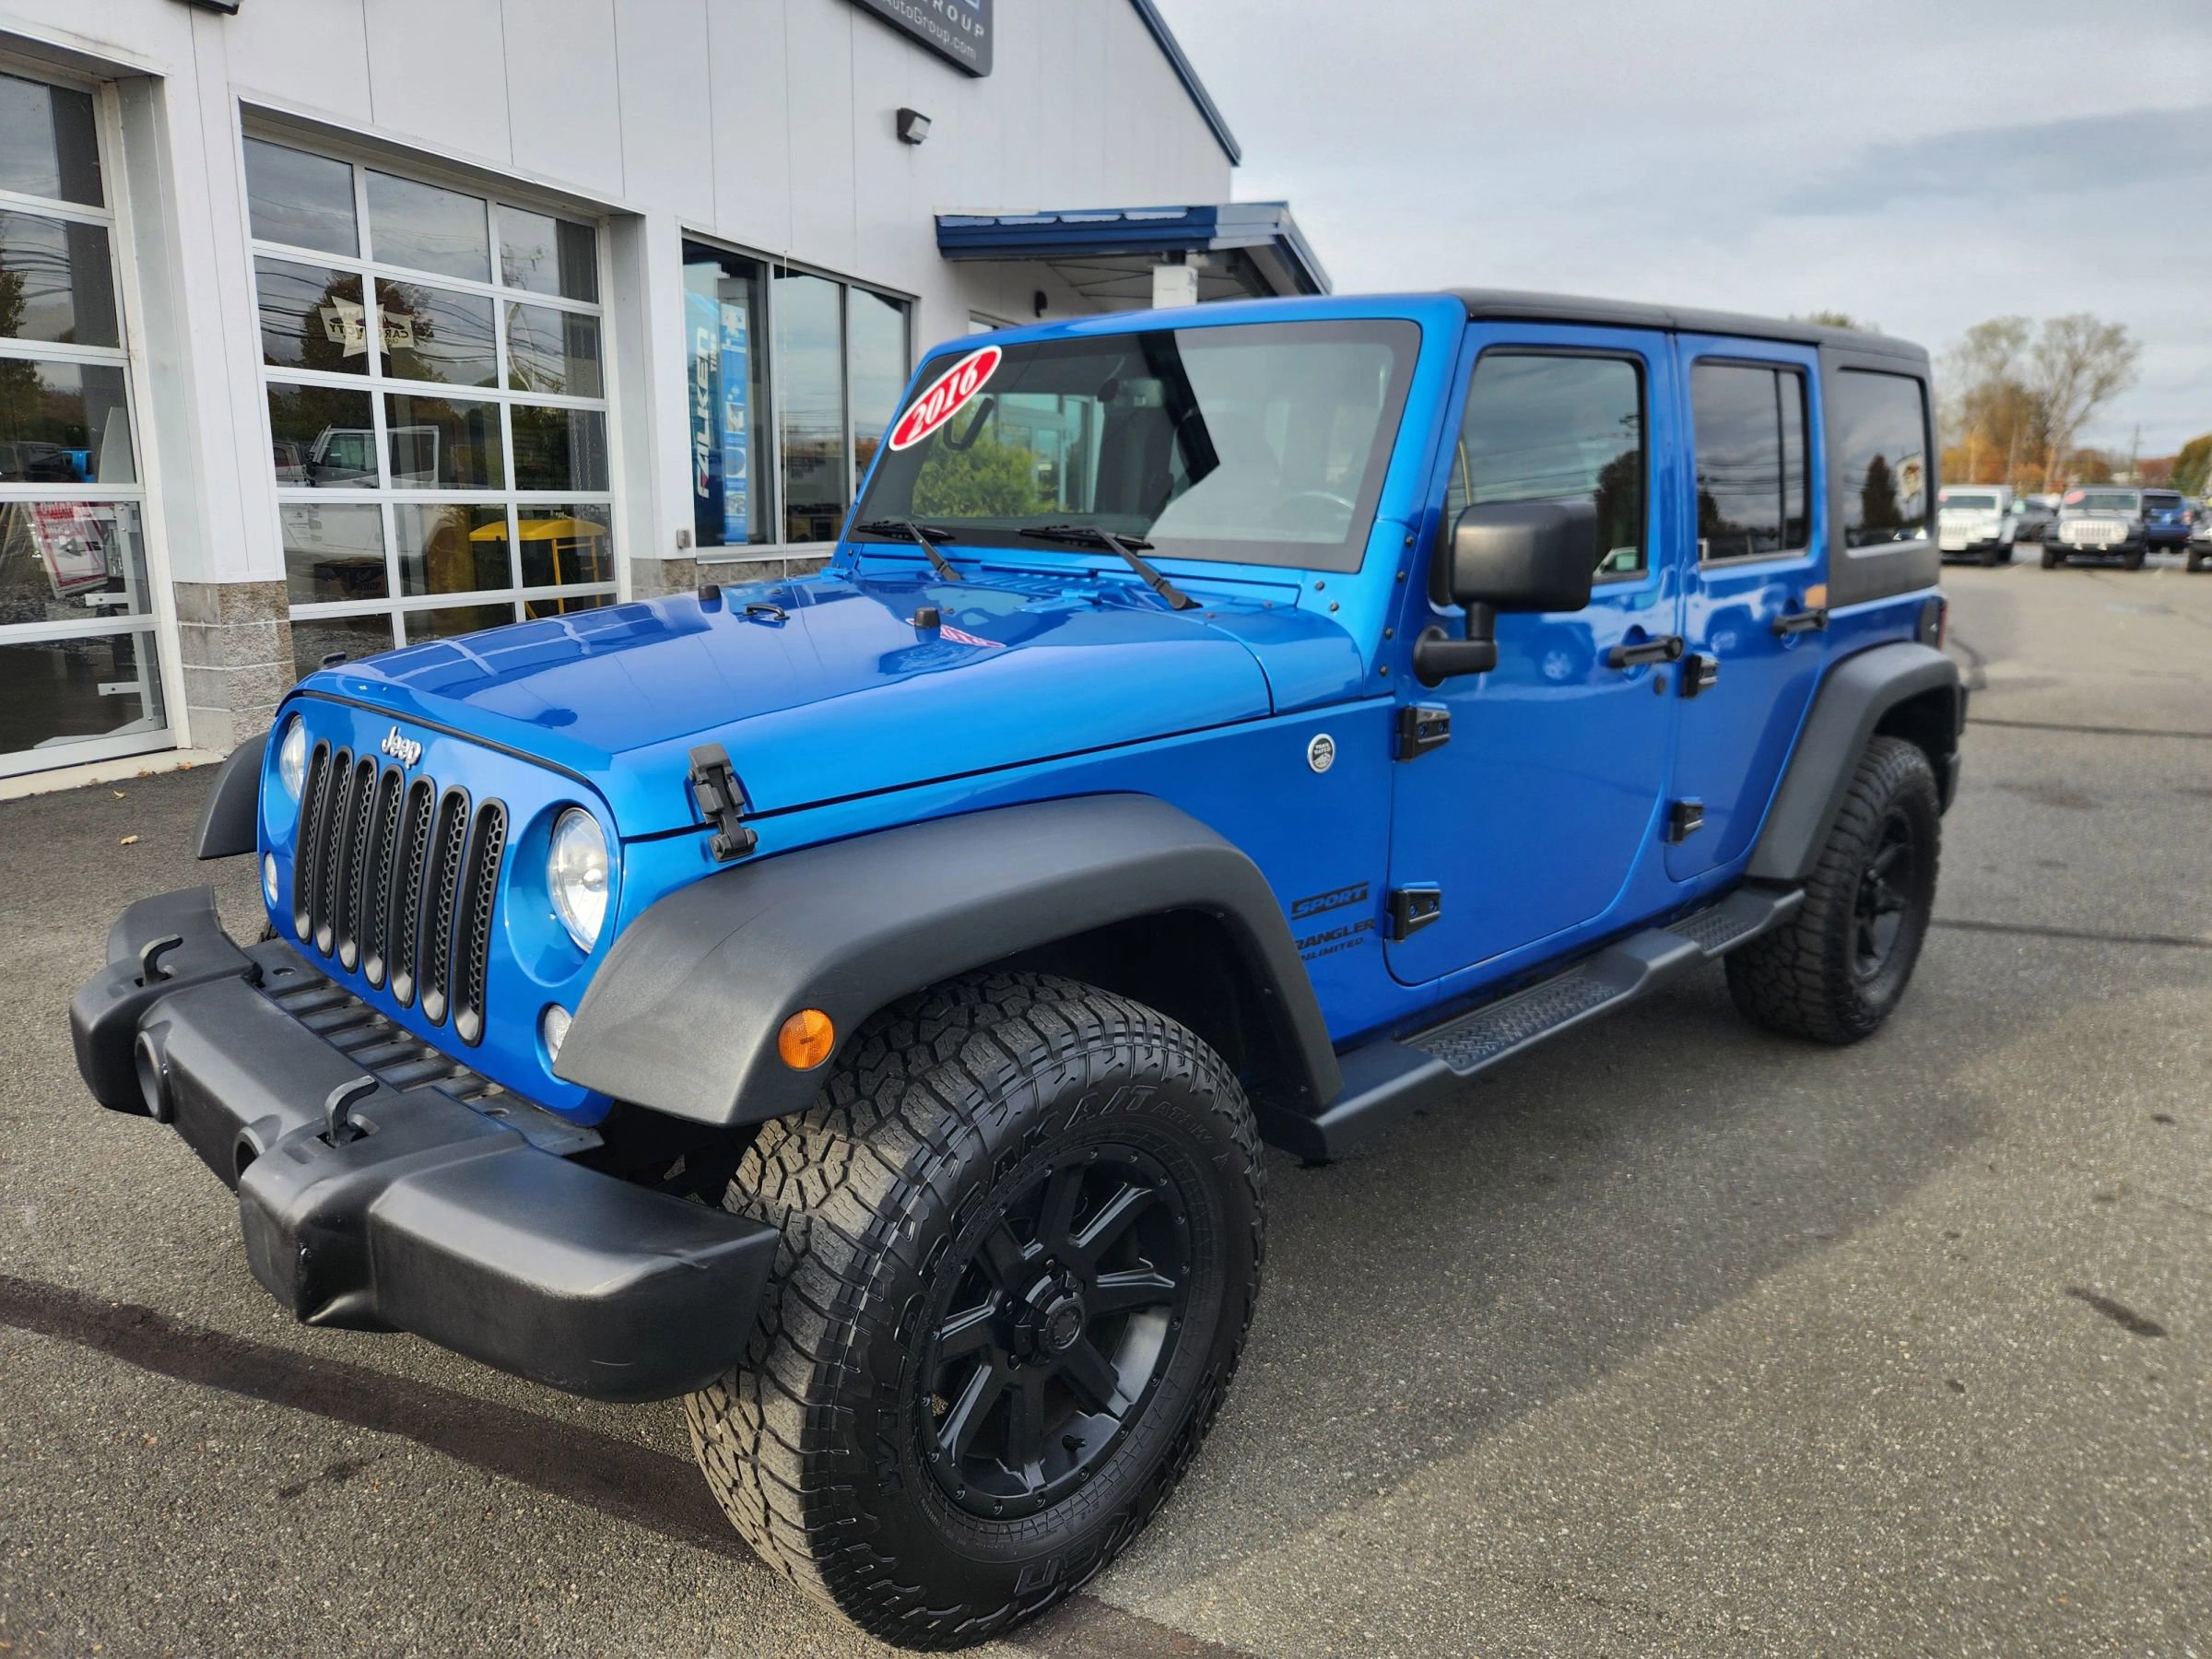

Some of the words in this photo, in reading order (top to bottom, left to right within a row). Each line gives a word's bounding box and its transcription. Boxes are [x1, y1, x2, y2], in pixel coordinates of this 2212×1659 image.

[924, 0, 984, 38] ROUP
[697, 326, 711, 500] FALKEN
[907, 356, 981, 443] 2016
[381, 725, 422, 770] Jeep
[1294, 884, 1369, 916] SPORT
[1295, 918, 1376, 950] RANGLER
[1300, 936, 1364, 961] NLIMITED
